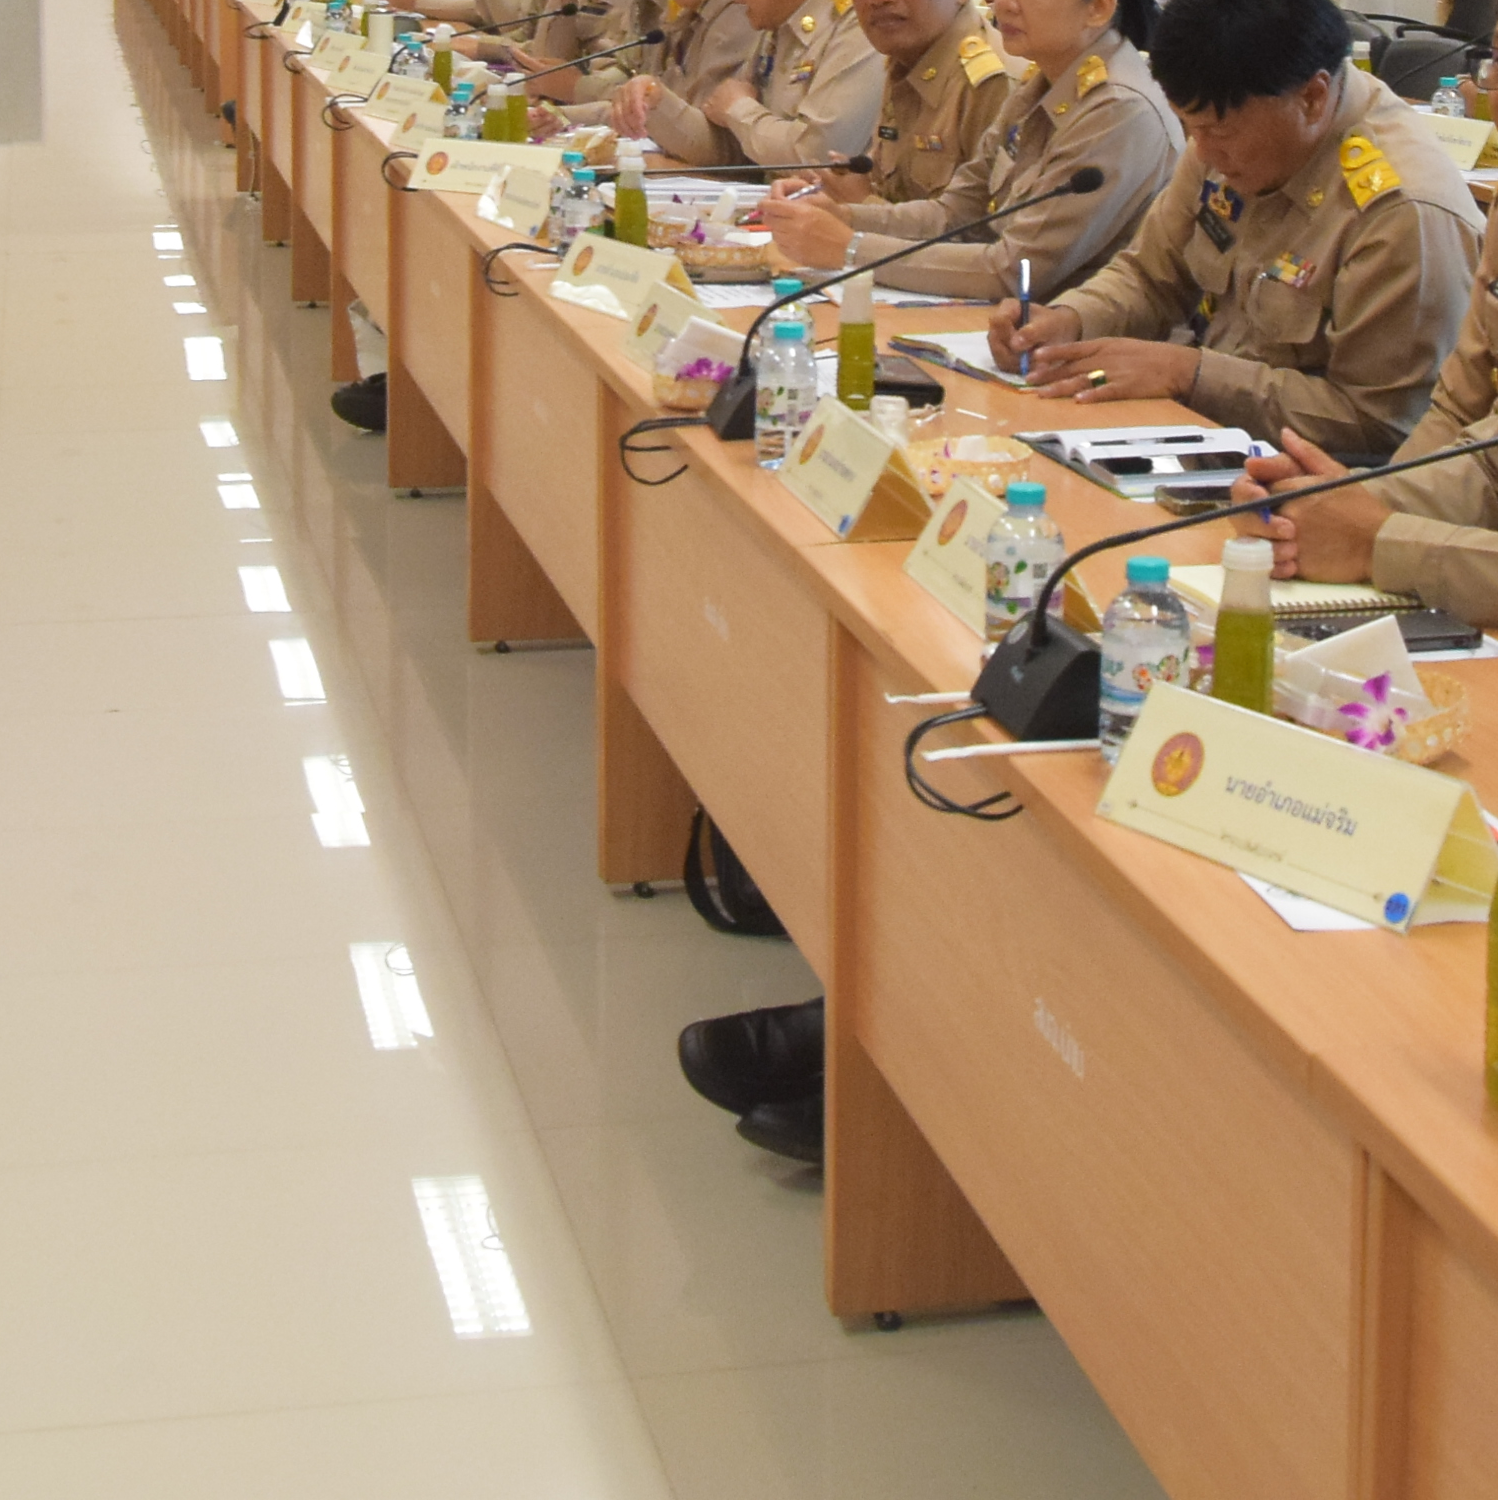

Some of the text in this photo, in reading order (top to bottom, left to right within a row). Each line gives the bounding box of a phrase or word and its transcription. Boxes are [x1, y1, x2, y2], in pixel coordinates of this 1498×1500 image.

[1224, 775, 1358, 837] นายอำเภอแม่จริม
